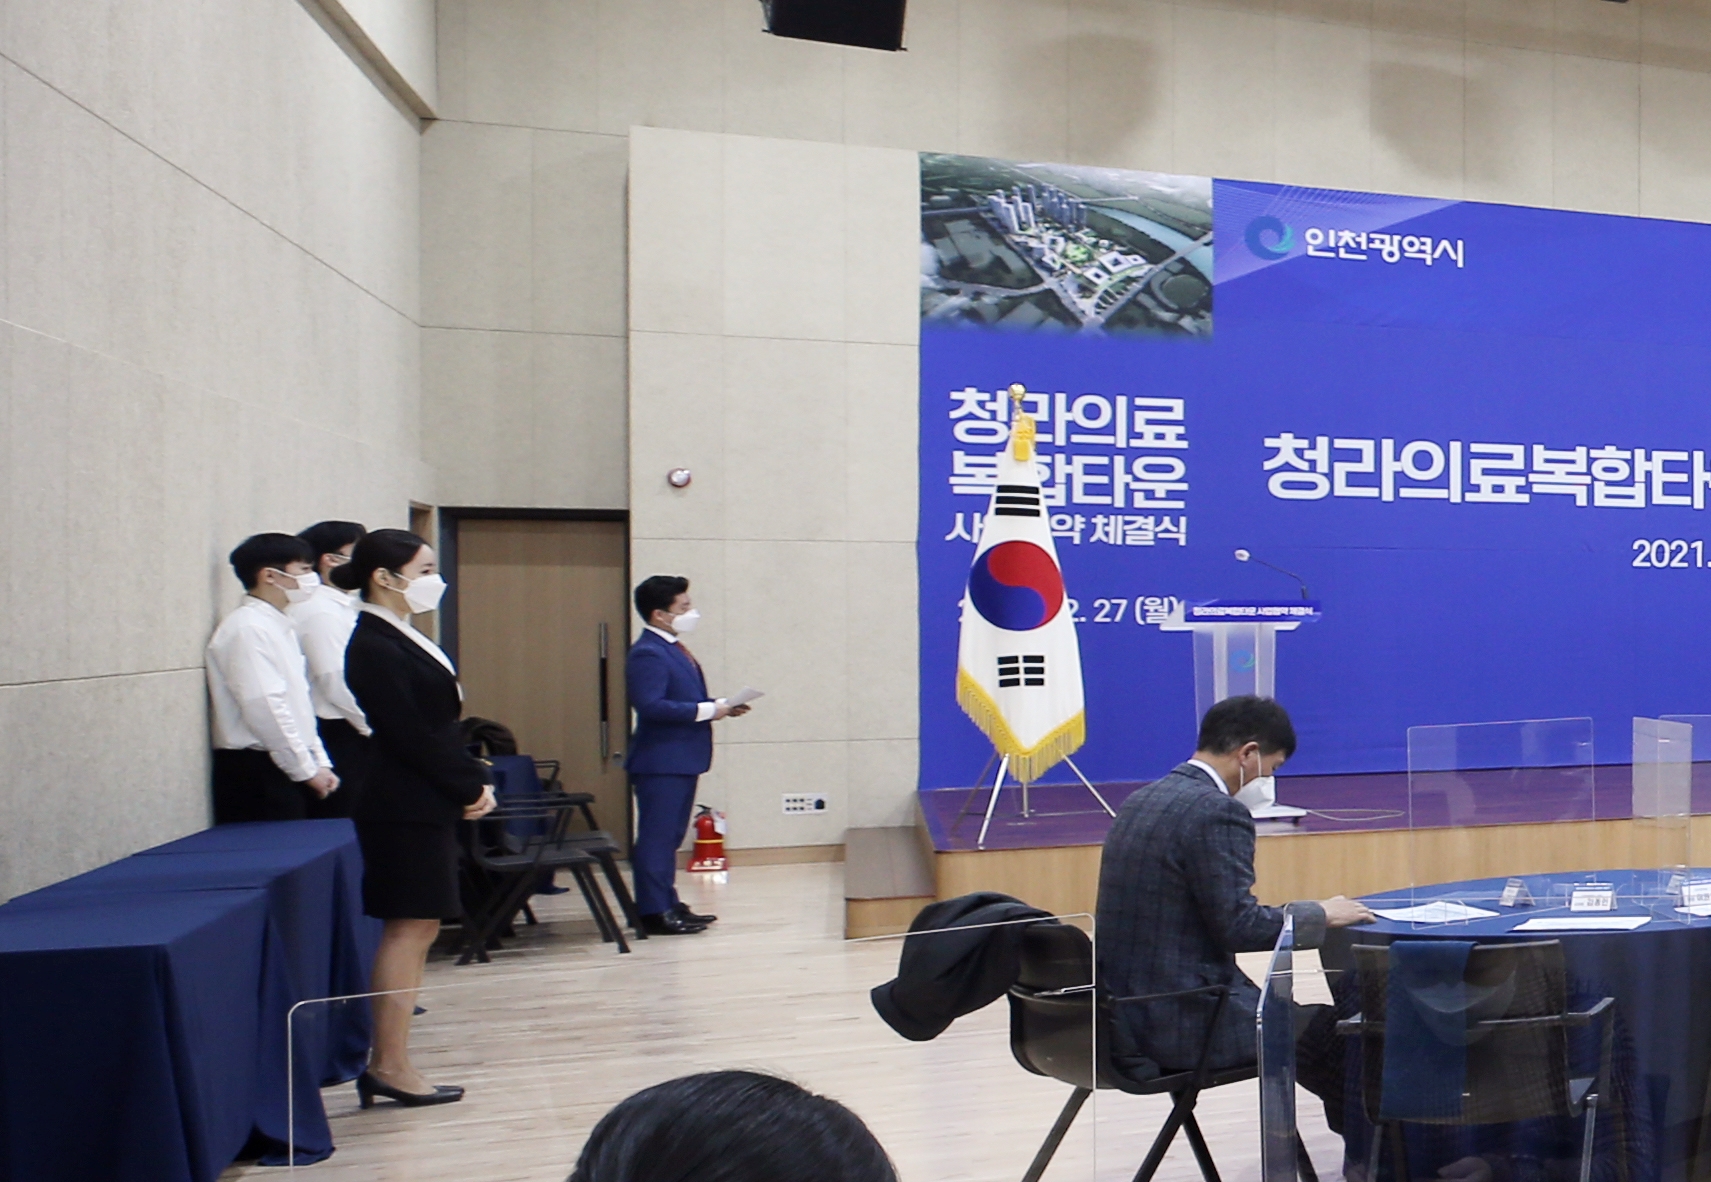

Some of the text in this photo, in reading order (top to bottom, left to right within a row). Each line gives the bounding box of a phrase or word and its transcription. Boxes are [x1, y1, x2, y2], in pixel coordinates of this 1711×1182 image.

[1304, 227, 1464, 268] 인천광역시
[1089, 514, 1188, 546] 체결식
[1093, 599, 1128, 622] 27
